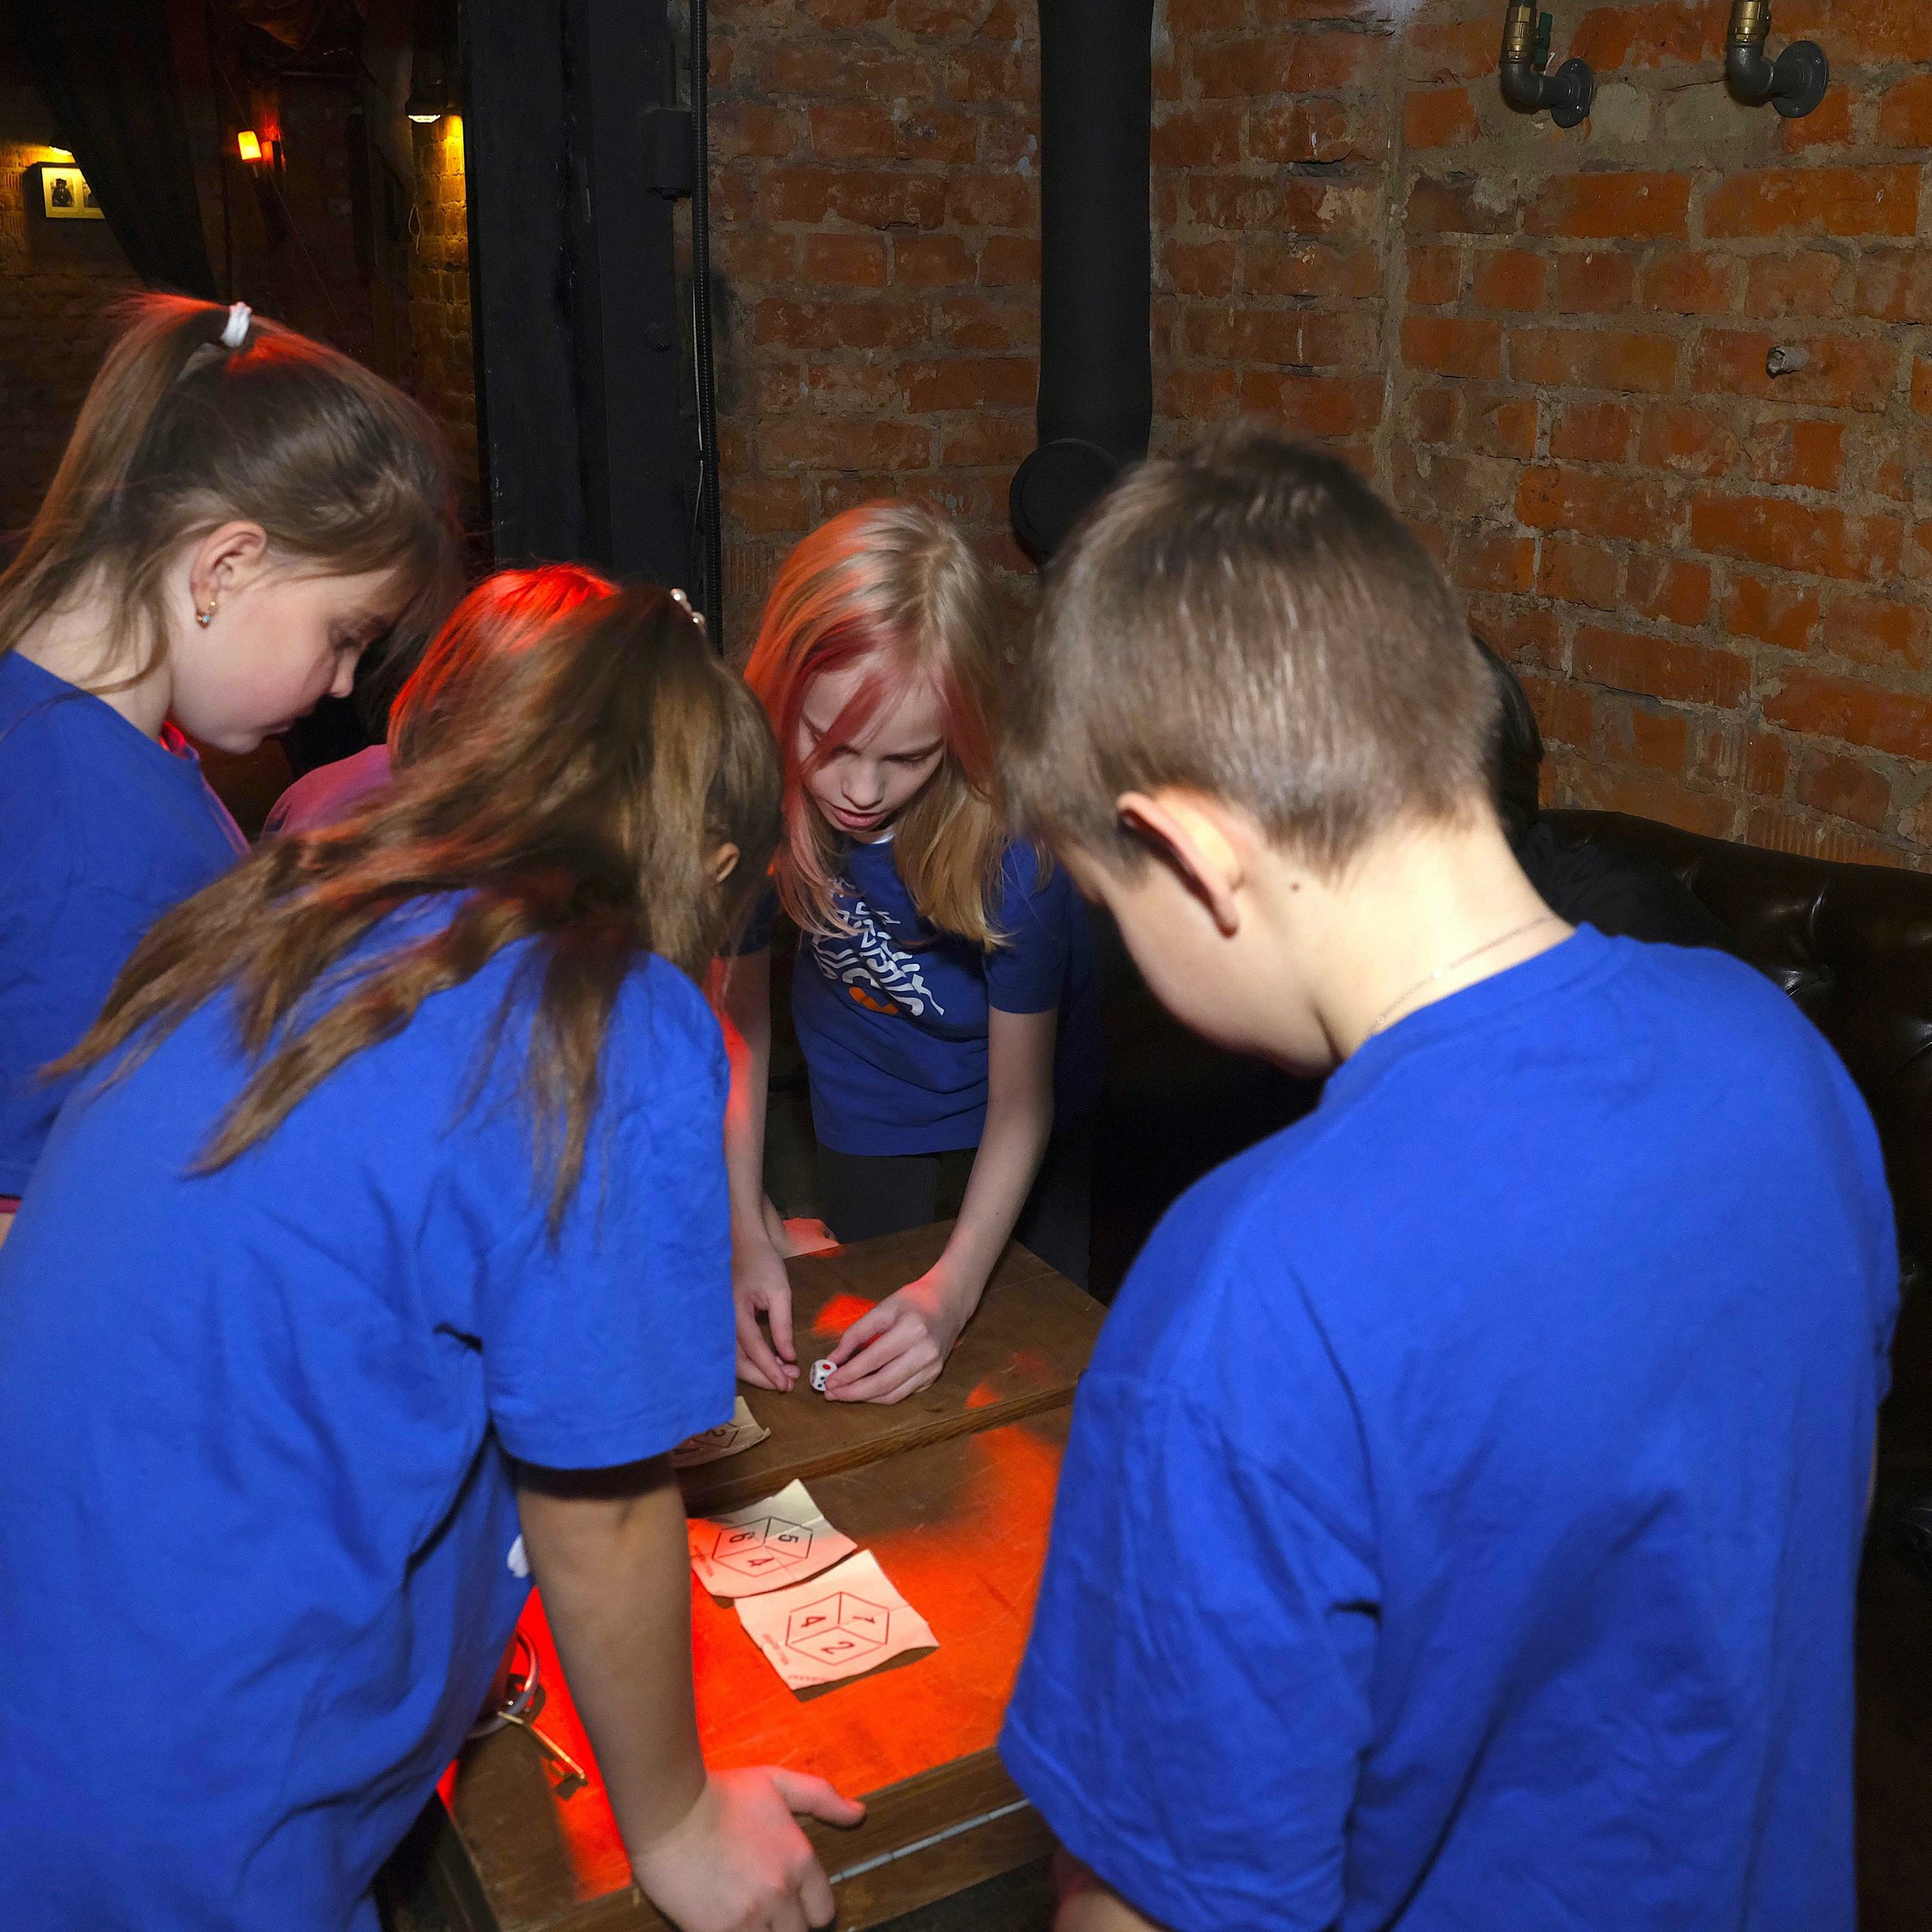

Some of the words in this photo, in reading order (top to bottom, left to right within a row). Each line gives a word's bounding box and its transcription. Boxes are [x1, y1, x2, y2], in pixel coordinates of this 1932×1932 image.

[729, 1531, 755, 1543] 6
[778, 1534, 799, 1544] 5
[746, 1557, 774, 1567] 4
[800, 1616, 826, 1628] 4
[852, 1615, 875, 1624] 1
[820, 1640, 855, 1655] 2
